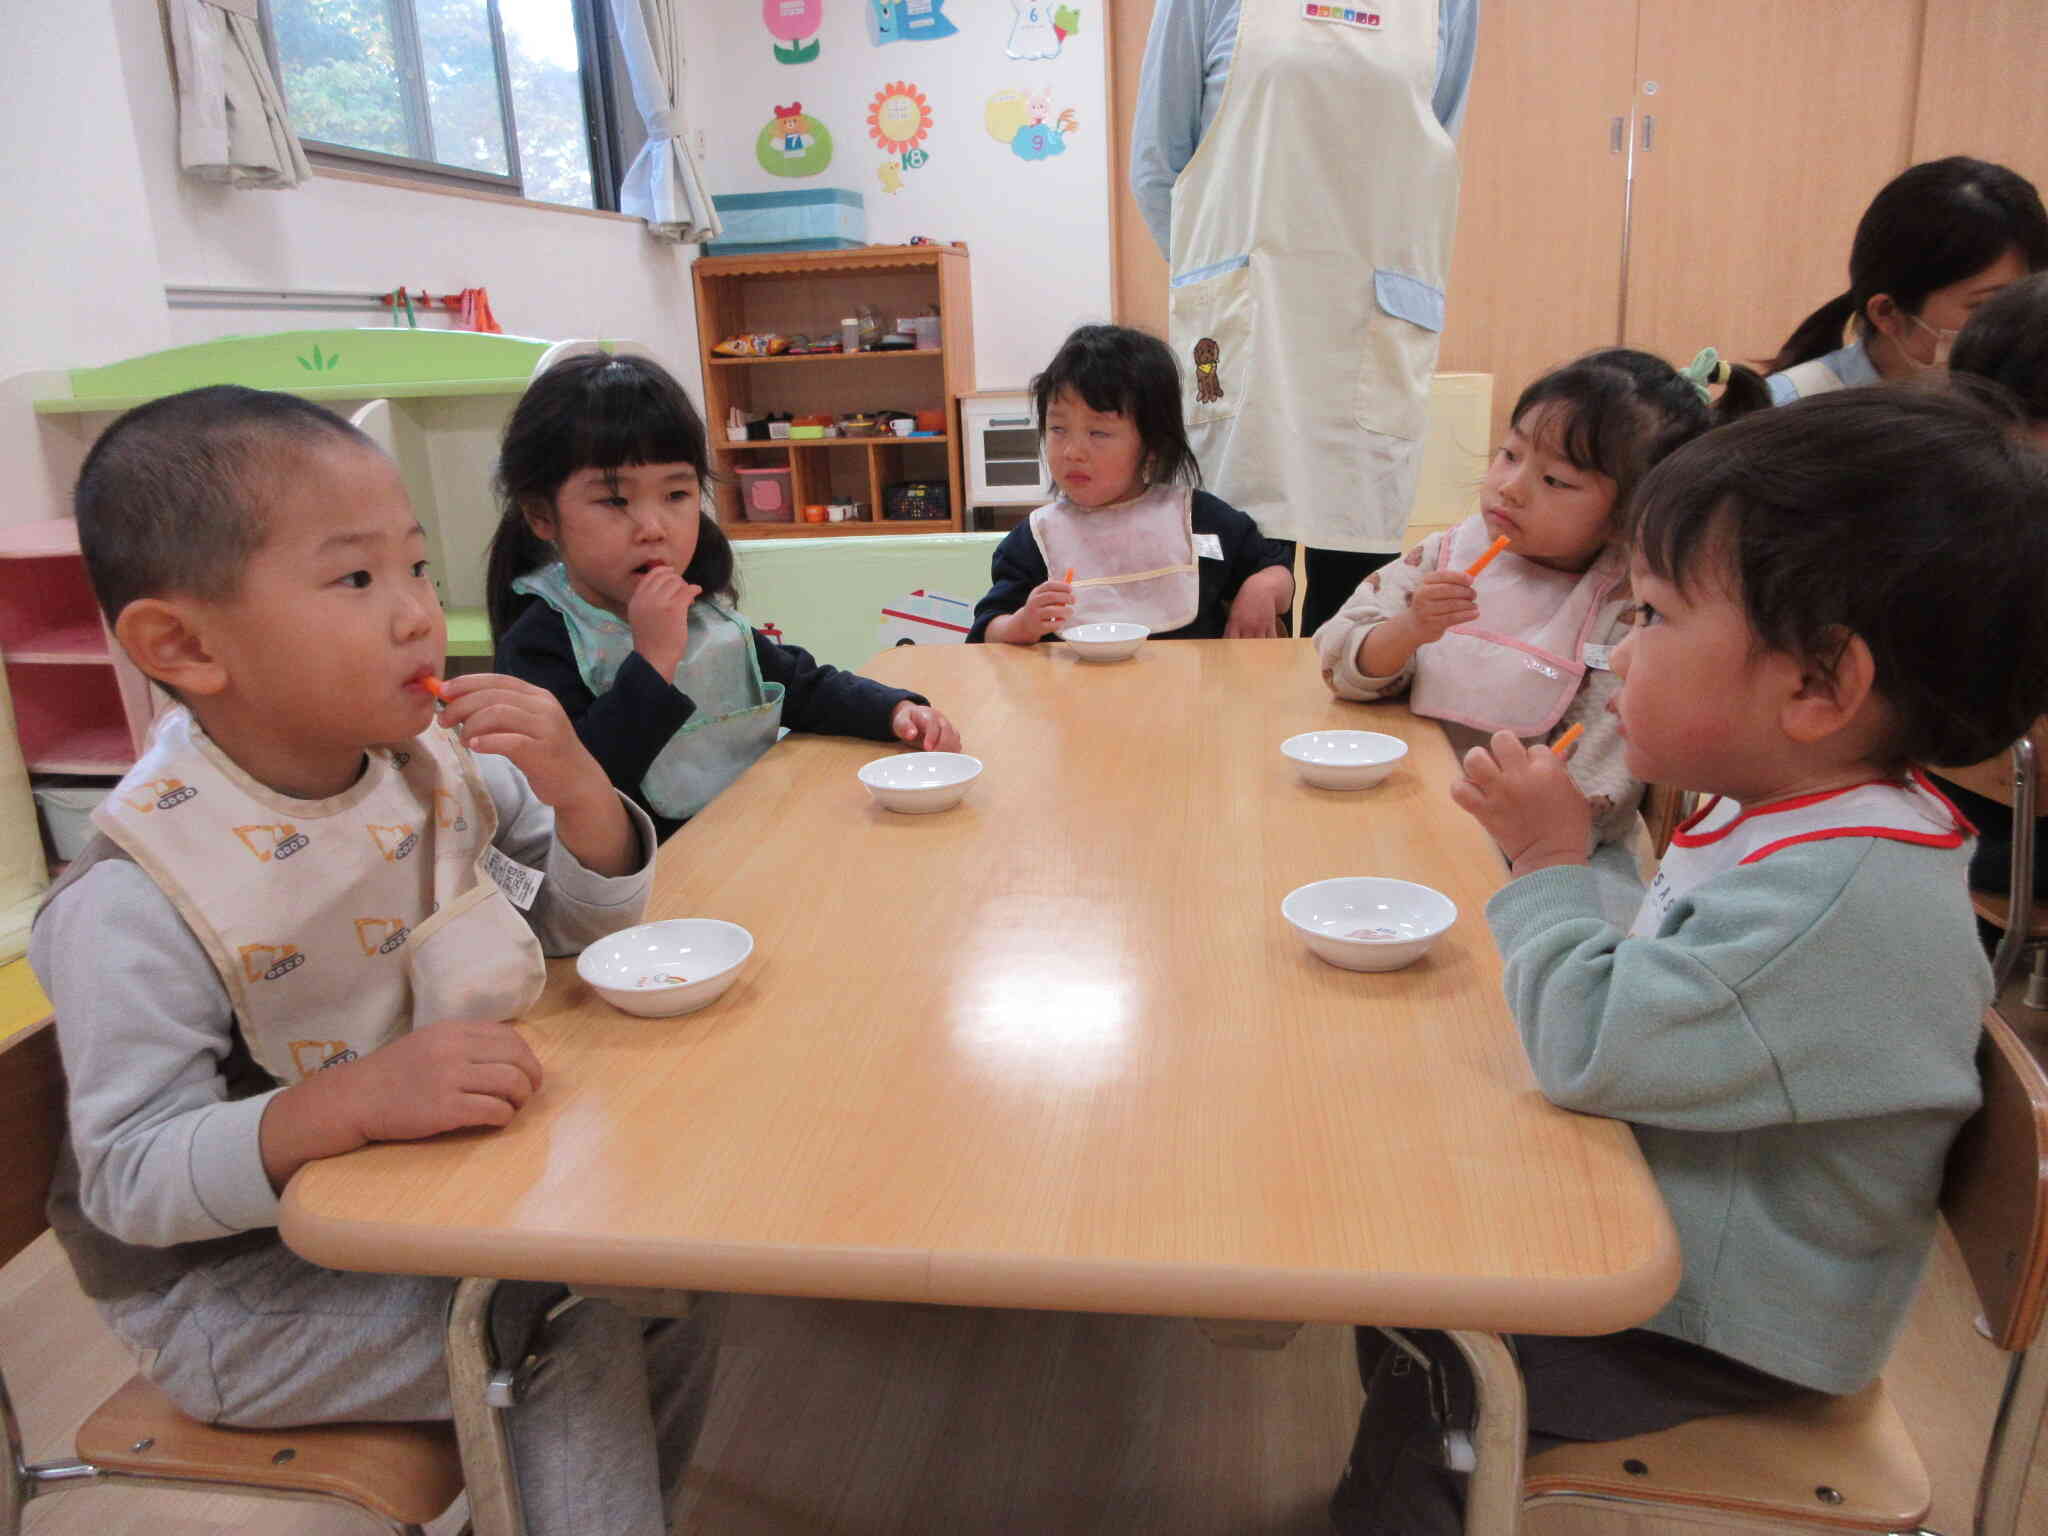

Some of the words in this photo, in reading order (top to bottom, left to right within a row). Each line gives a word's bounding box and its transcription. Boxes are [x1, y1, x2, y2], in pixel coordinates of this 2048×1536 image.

[1029, 7, 1038, 23] 6
[1031, 135, 1043, 152] 9
[912, 150, 921, 166] 8
[1654, 869, 1675, 912] SAS
